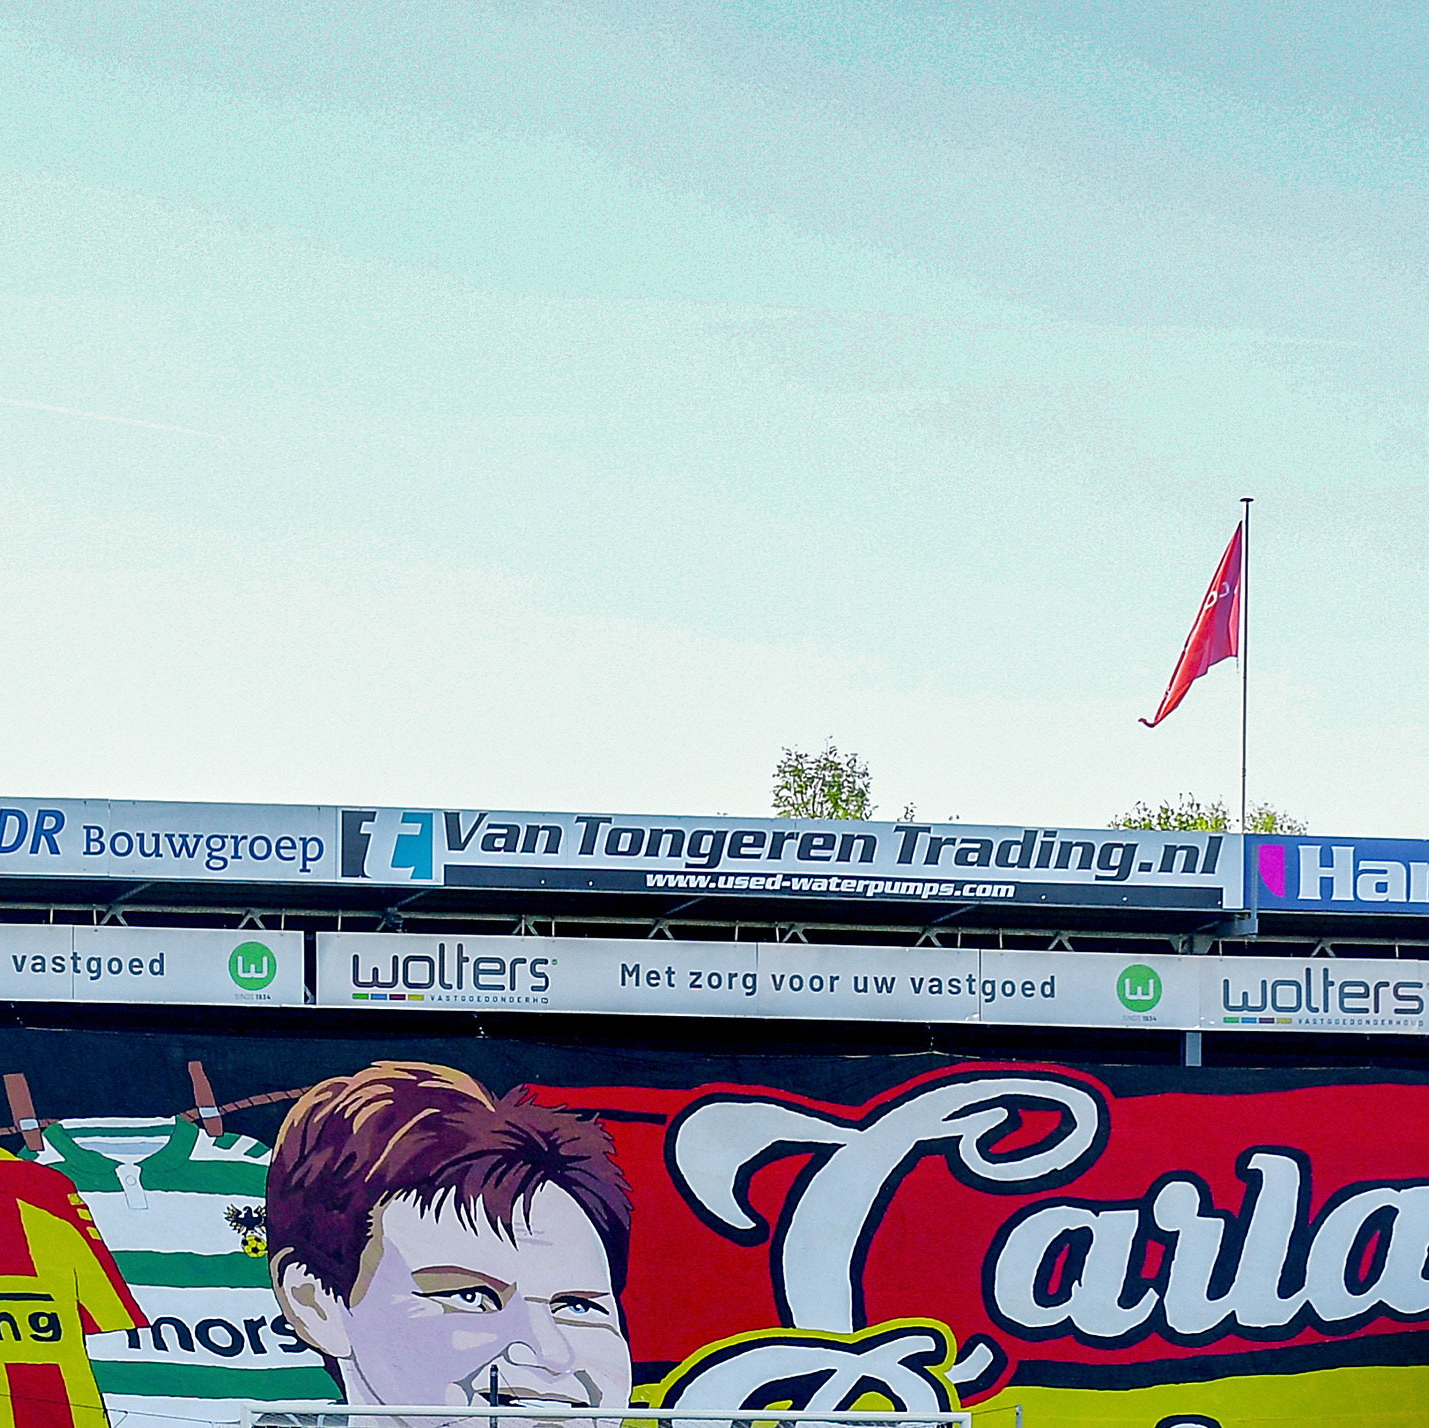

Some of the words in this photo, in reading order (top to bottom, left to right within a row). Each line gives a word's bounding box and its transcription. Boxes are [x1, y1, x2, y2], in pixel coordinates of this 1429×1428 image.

[82, 825, 324, 873] Bouwgroep
[443, 811, 562, 855] Van
[574, 815, 878, 869] Tongeren
[893, 825, 1223, 881] Trading.nl
[646, 872, 1015, 899] www.used-waterpumps.com
[13, 952, 166, 982] vastgoed
[352, 943, 549, 991] wolters
[620, 963, 676, 988] Met
[689, 968, 758, 996] zorg
[772, 972, 840, 993] voor
[853, 974, 896, 995] uw
[911, 974, 1057, 1003] vastgoed
[1223, 967, 1424, 1014] wolters
